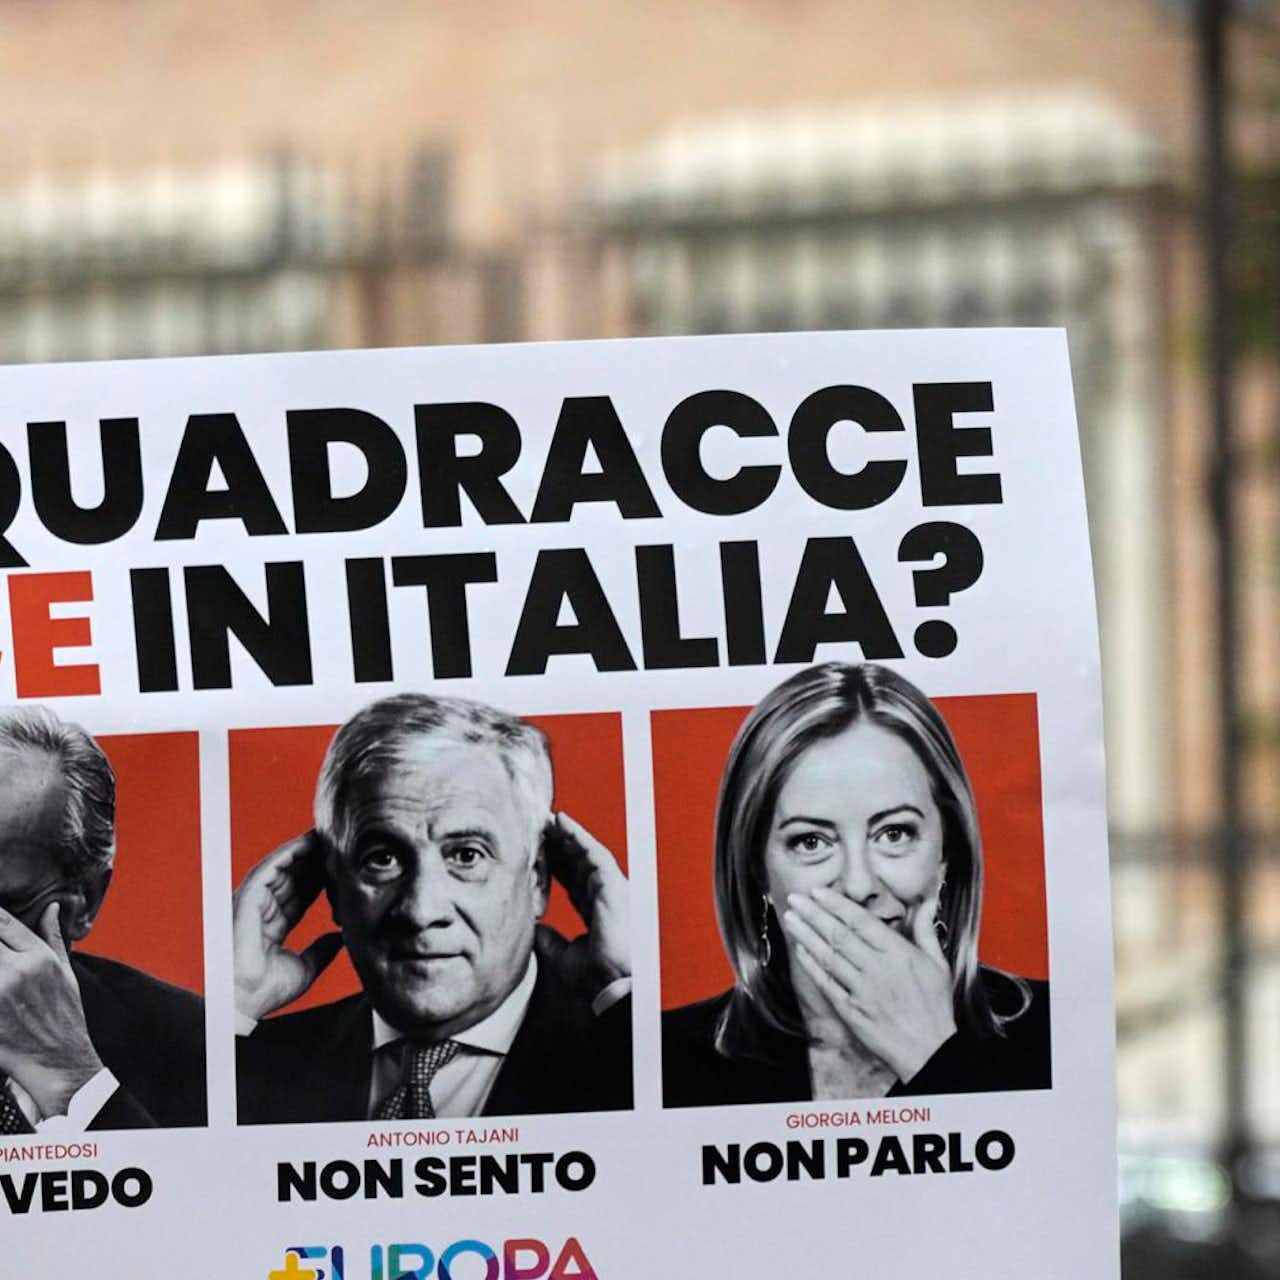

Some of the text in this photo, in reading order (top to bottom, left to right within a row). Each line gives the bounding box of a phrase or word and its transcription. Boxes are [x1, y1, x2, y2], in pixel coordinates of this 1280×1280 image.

[130, 561, 313, 693] IN
[345, 521, 984, 683] ITALIA?
[367, 1128, 519, 1148] ANTONIO TAJANI
[786, 1108, 931, 1129] GIORGIA MELONI
[277, 1151, 596, 1202] NON SENTO
[702, 1130, 1016, 1185] NON PARLO
